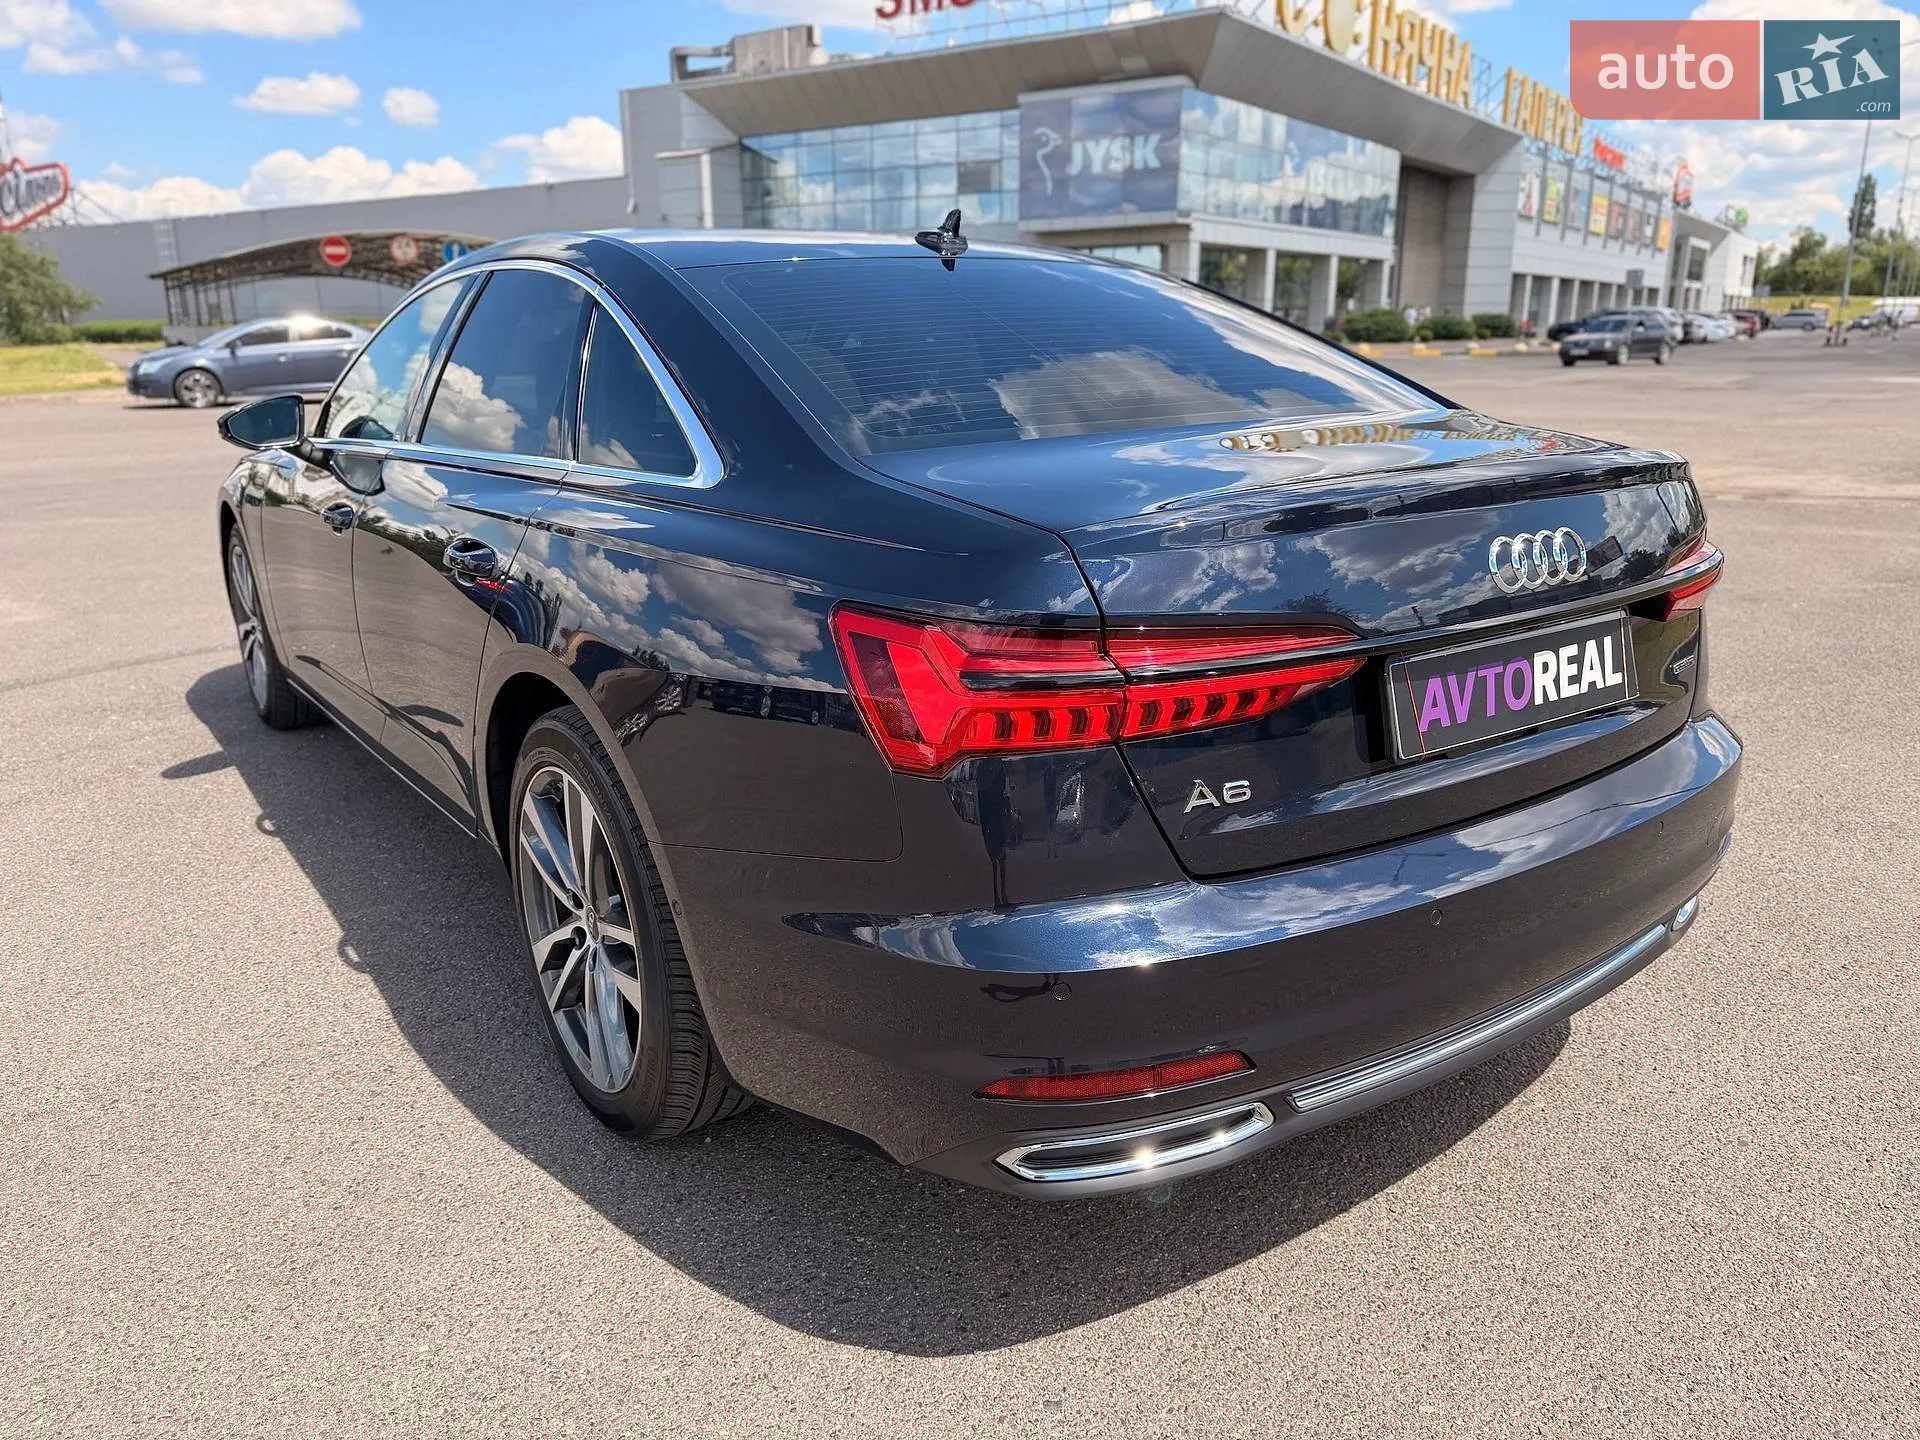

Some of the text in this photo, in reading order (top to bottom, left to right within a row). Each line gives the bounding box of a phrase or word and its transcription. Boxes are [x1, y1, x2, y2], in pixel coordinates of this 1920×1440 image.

[1065, 132, 1162, 176] JYSK
[1419, 635, 1623, 732] AVTOREAL
[1183, 779, 1252, 813] A6
